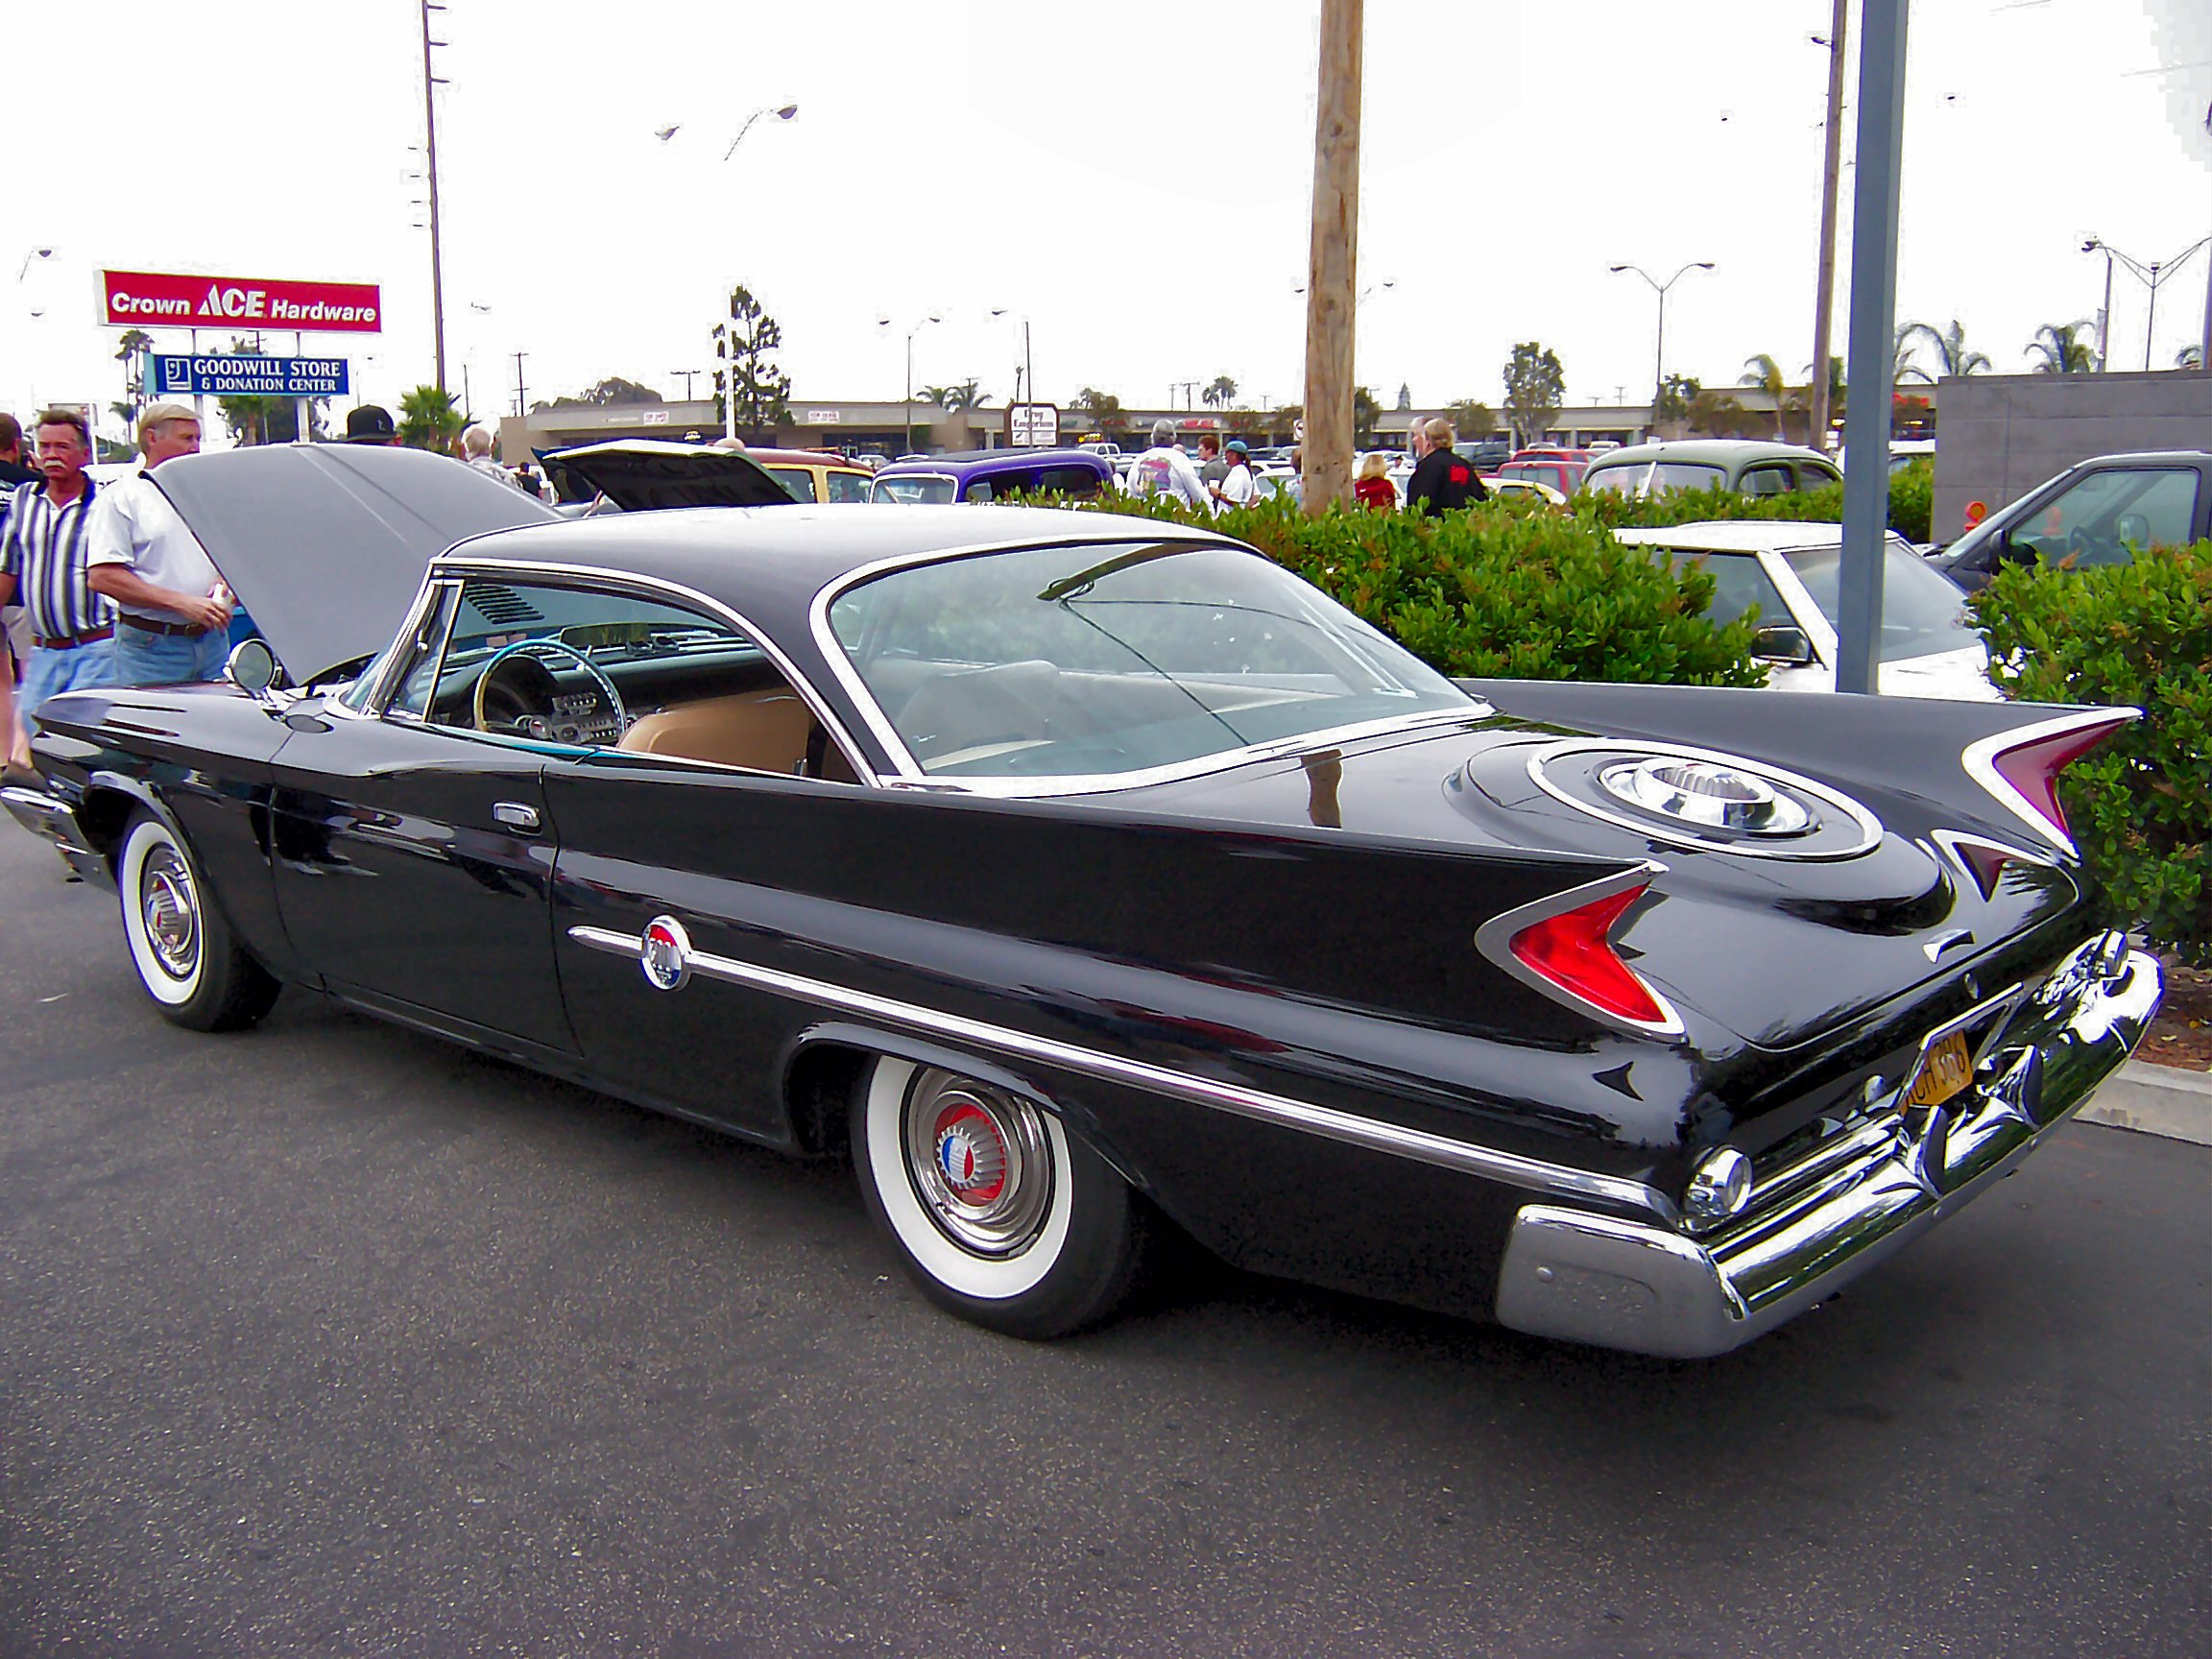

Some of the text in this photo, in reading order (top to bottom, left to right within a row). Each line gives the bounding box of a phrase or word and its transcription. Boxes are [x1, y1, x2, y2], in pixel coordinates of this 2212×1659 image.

[111, 284, 376, 323] Crown ACE Hardware
[194, 359, 341, 377] GOODWILL STORE
[202, 377, 336, 392] & DONATION CENTER
